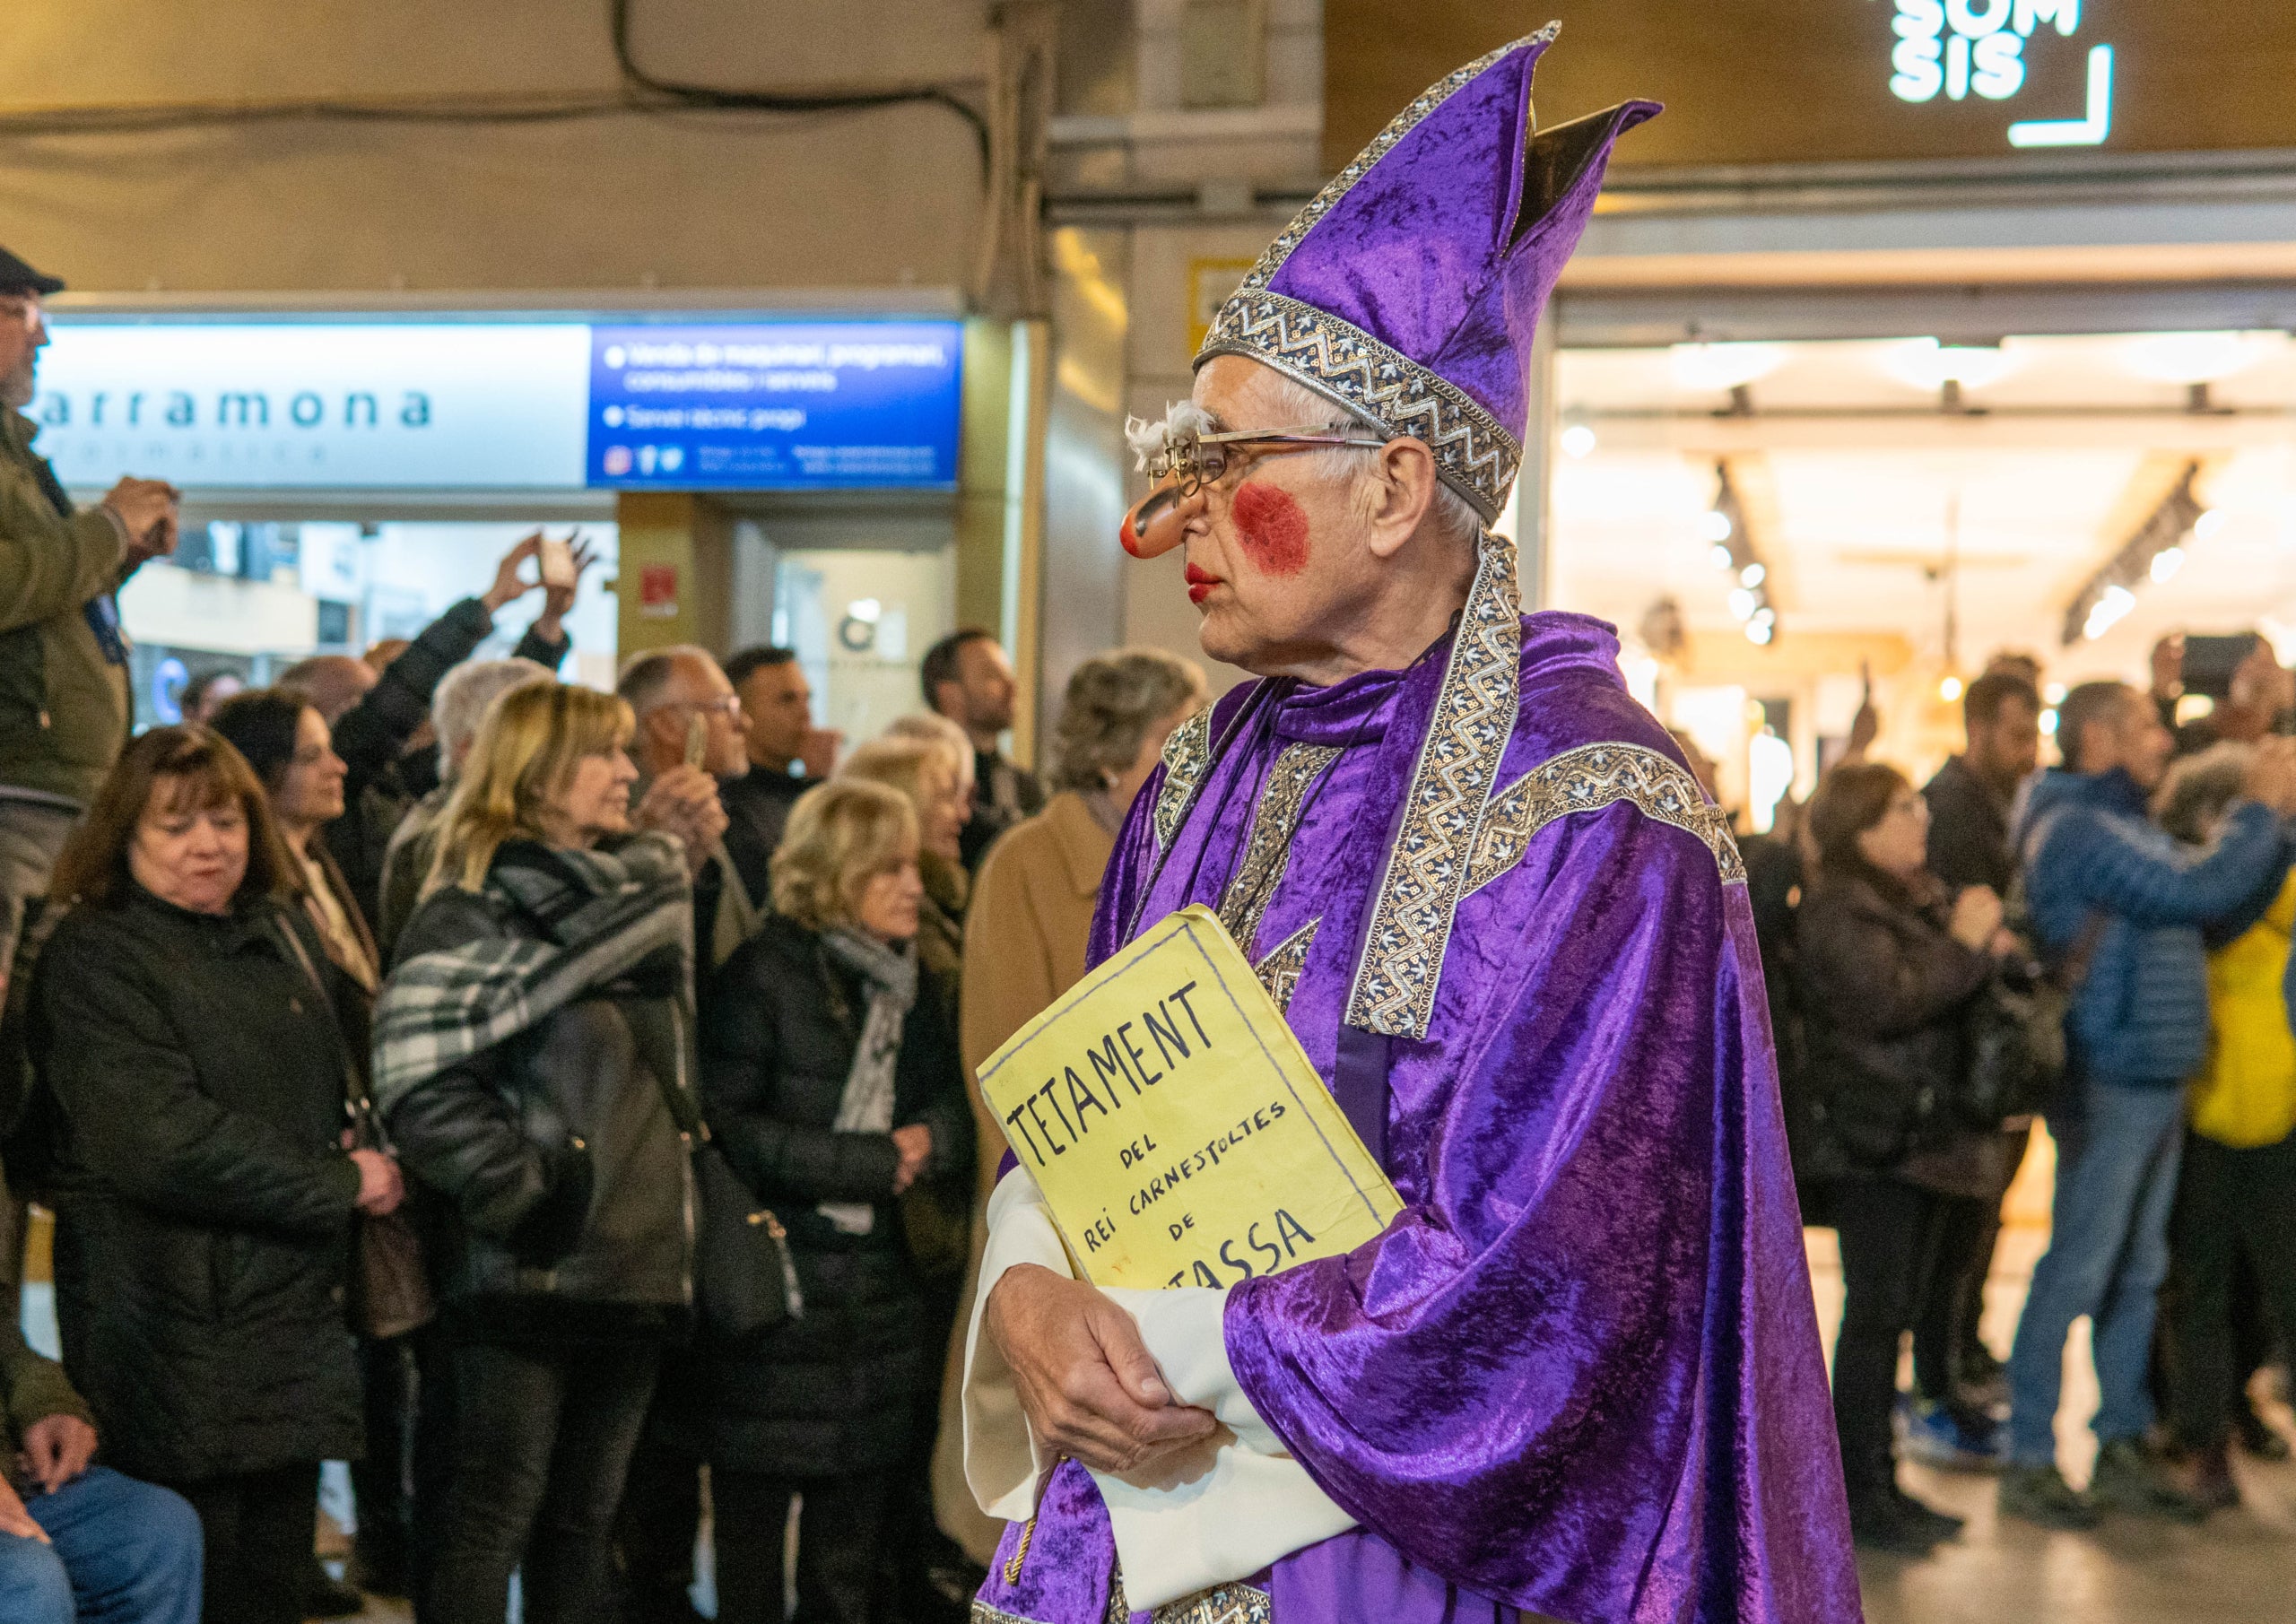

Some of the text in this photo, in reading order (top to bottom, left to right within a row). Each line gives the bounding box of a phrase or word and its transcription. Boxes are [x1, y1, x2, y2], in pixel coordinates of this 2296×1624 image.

[1891, 0, 2082, 40] SOM
[1889, 30, 2027, 103] SIS
[1007, 980, 1211, 1167] TETAMENT
[1120, 1134, 1156, 1169] DEL
[1130, 1101, 1285, 1215] CARNESTOLTES
[1169, 1212, 1195, 1241] DE
